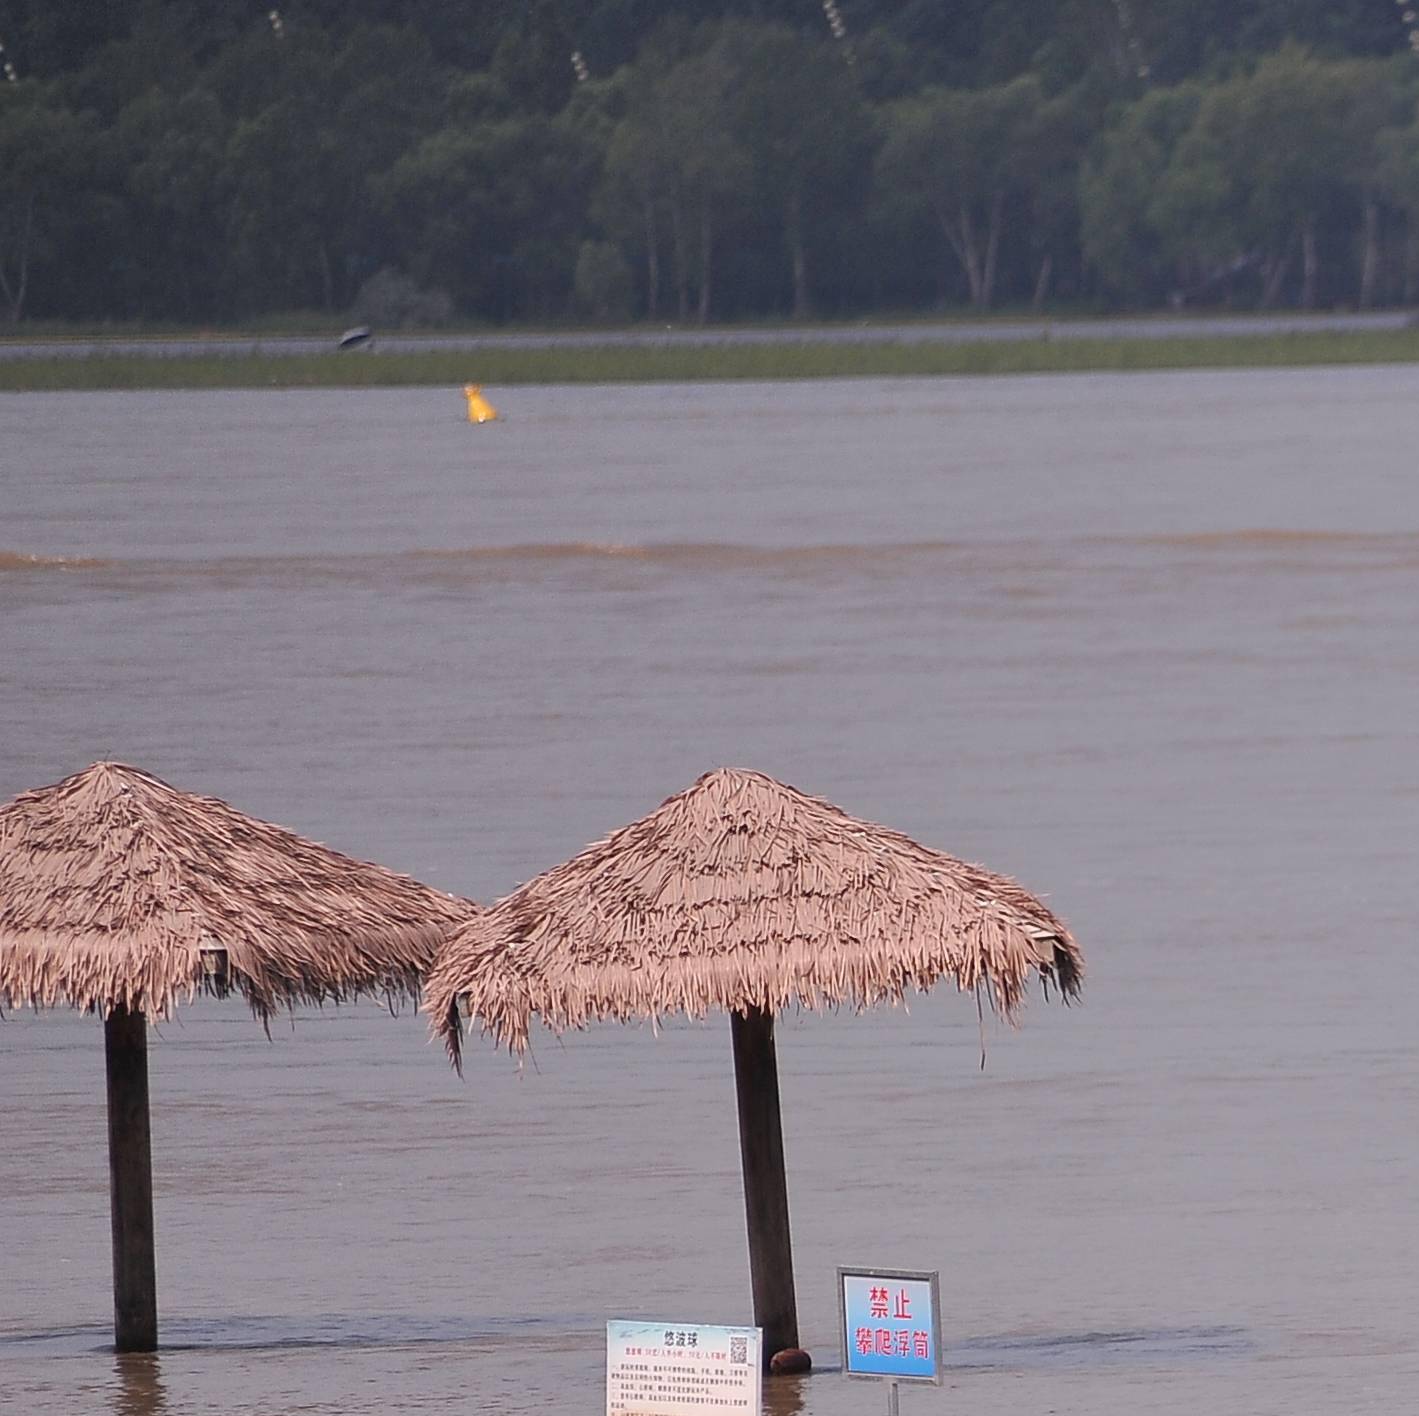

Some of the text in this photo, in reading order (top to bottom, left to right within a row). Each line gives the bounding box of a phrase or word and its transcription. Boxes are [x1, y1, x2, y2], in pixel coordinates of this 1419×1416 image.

[869, 1286, 912, 1320] 禁止
[855, 1327, 929, 1360] 攀爬浮筒
